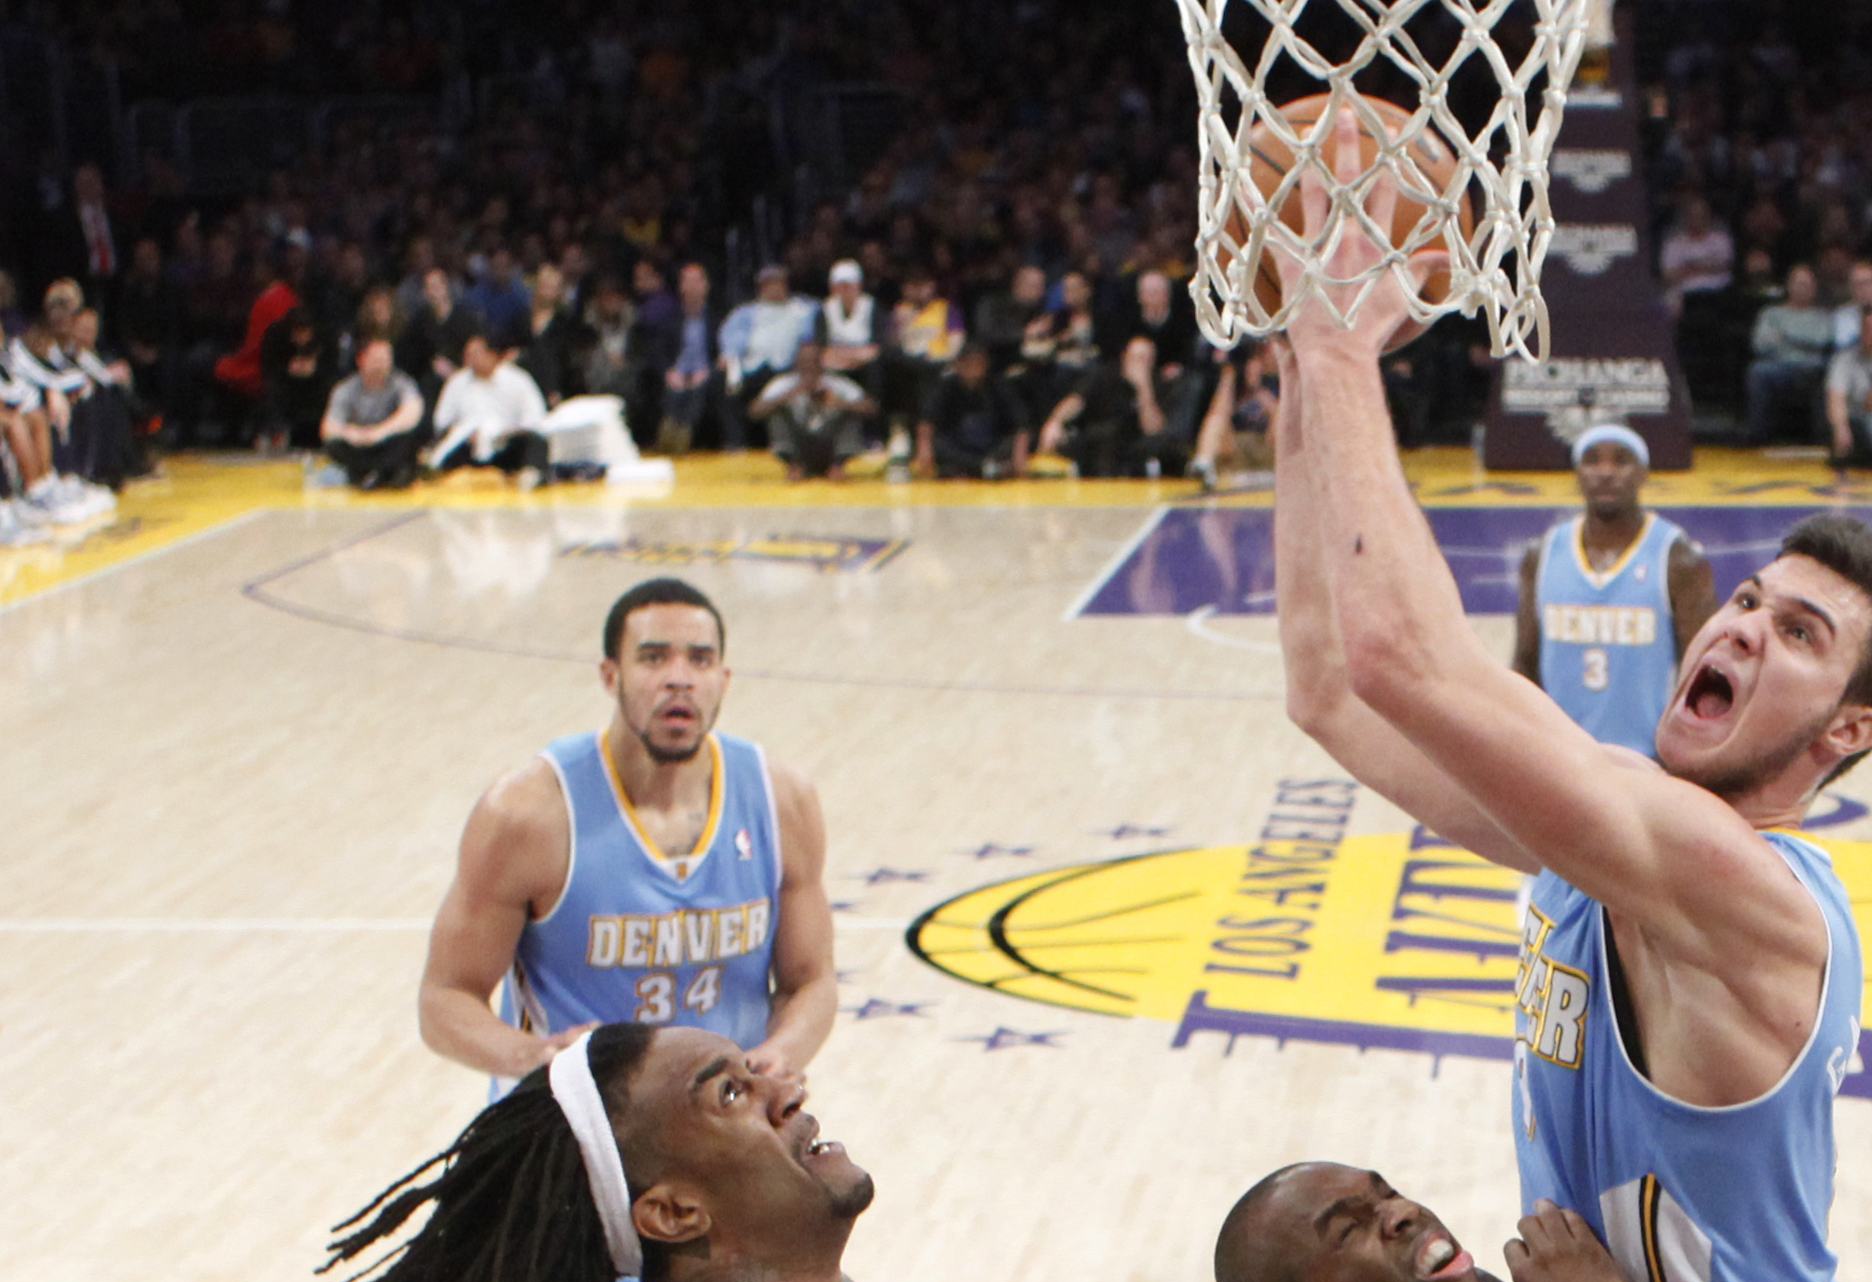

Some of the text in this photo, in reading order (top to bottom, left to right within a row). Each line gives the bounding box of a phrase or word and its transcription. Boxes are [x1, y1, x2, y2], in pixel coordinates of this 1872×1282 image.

[1544, 604, 1657, 645] DENVER
[1582, 648, 1608, 693] 3
[1203, 778, 1360, 980] LOS ANGELES
[586, 897, 771, 968] DENVER
[634, 965, 725, 1025] 34
